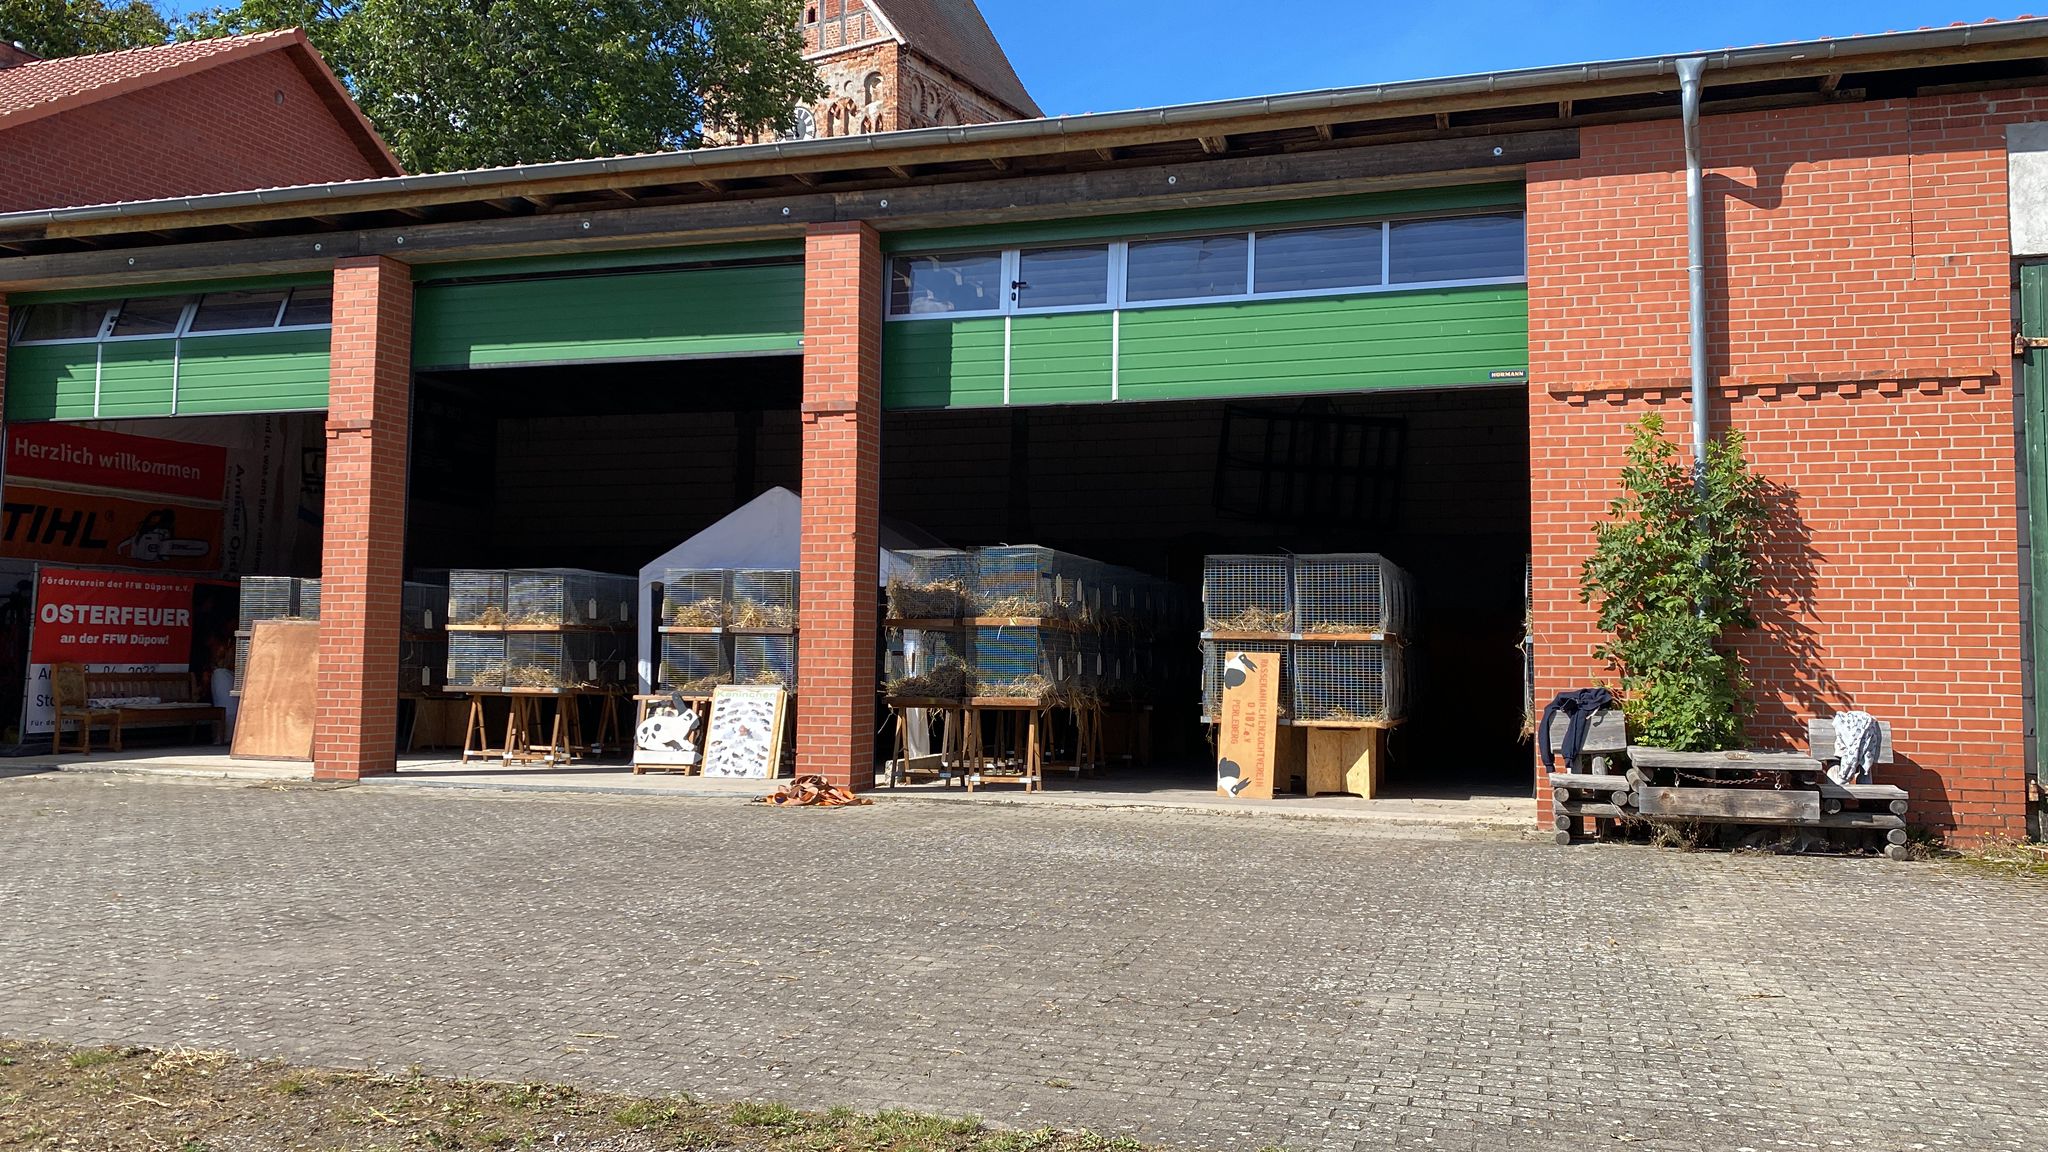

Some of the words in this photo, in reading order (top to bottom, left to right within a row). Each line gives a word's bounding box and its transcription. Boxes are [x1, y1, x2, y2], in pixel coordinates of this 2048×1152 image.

[15, 437, 93, 465] Herzlich
[99, 452, 201, 480] willkommen
[41, 576, 105, 588] Förderverein
[125, 581, 142, 589] FFW
[41, 603, 190, 627] OSTERFEUER
[60, 634, 76, 644] an
[79, 633, 100, 644] der
[102, 634, 128, 644] FFW
[130, 634, 169, 647] Düpow!
[1230, 699, 1241, 745] PERLEBERG
